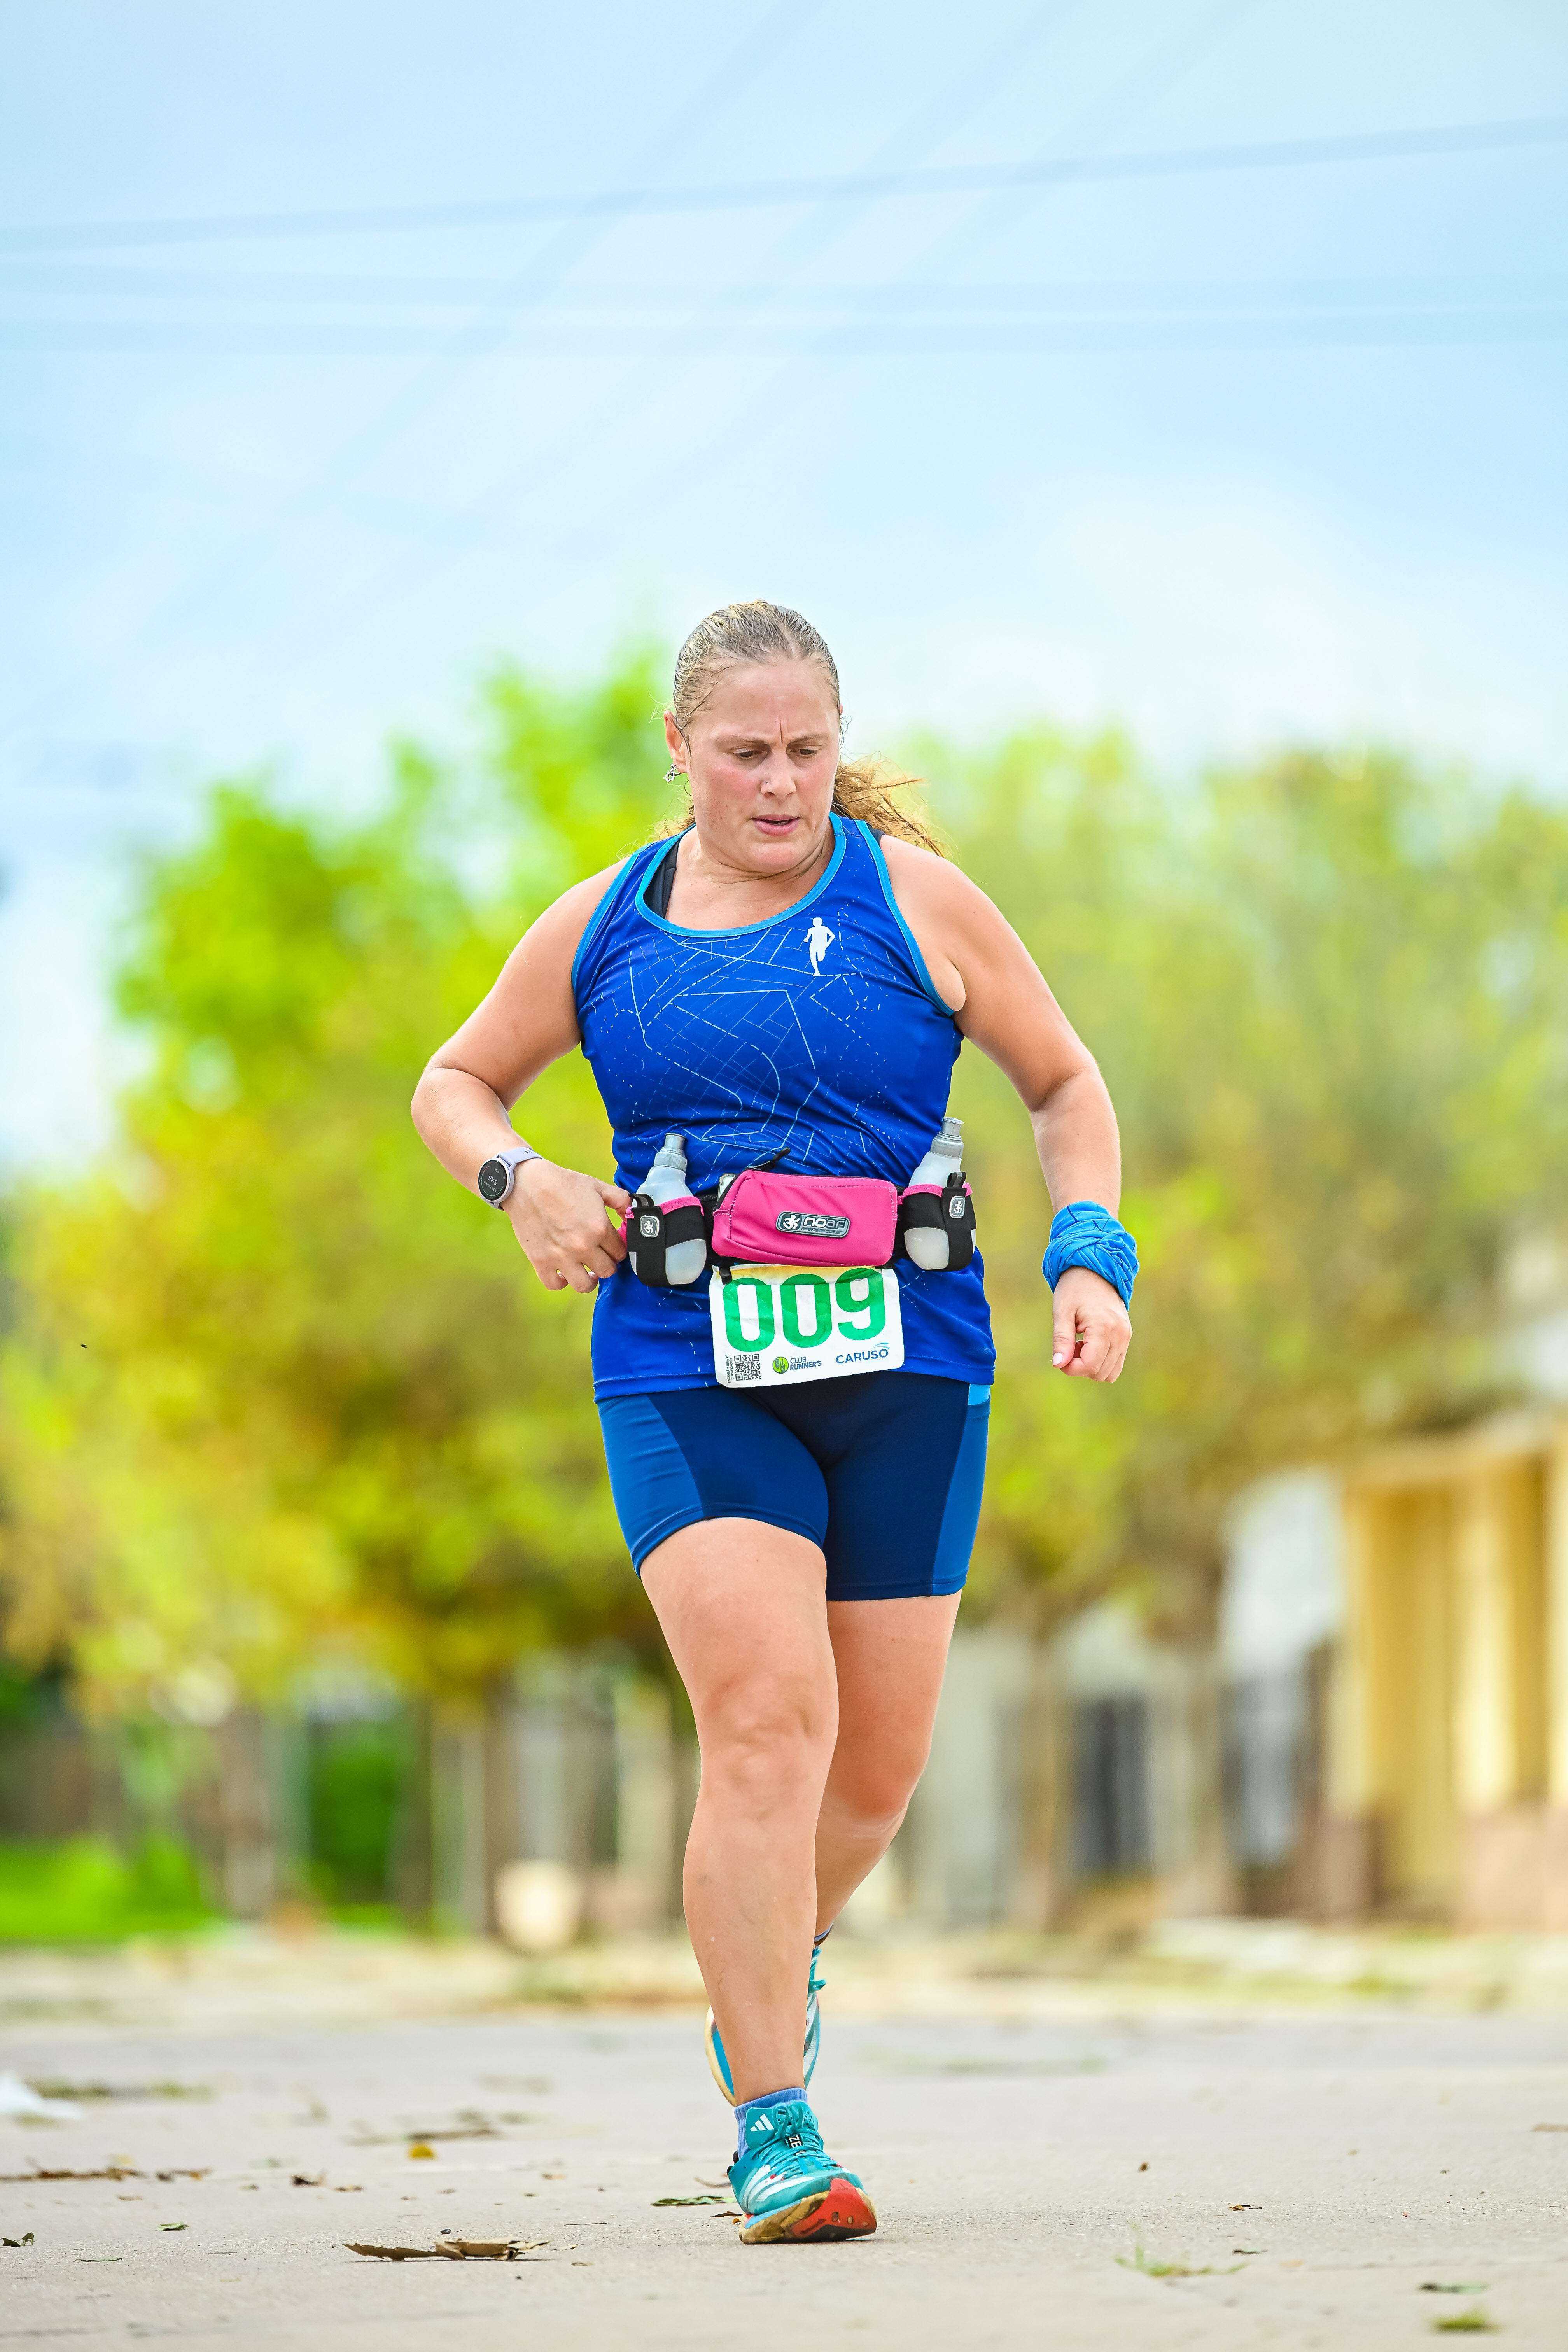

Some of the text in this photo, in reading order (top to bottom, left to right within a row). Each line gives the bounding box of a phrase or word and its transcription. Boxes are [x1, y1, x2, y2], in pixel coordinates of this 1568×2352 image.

[803, 1217, 845, 1228] noaf
[723, 1267, 886, 1352] 009
[836, 1348, 889, 1364] CARUSO
[790, 1360, 822, 1370] RUNNER'S
